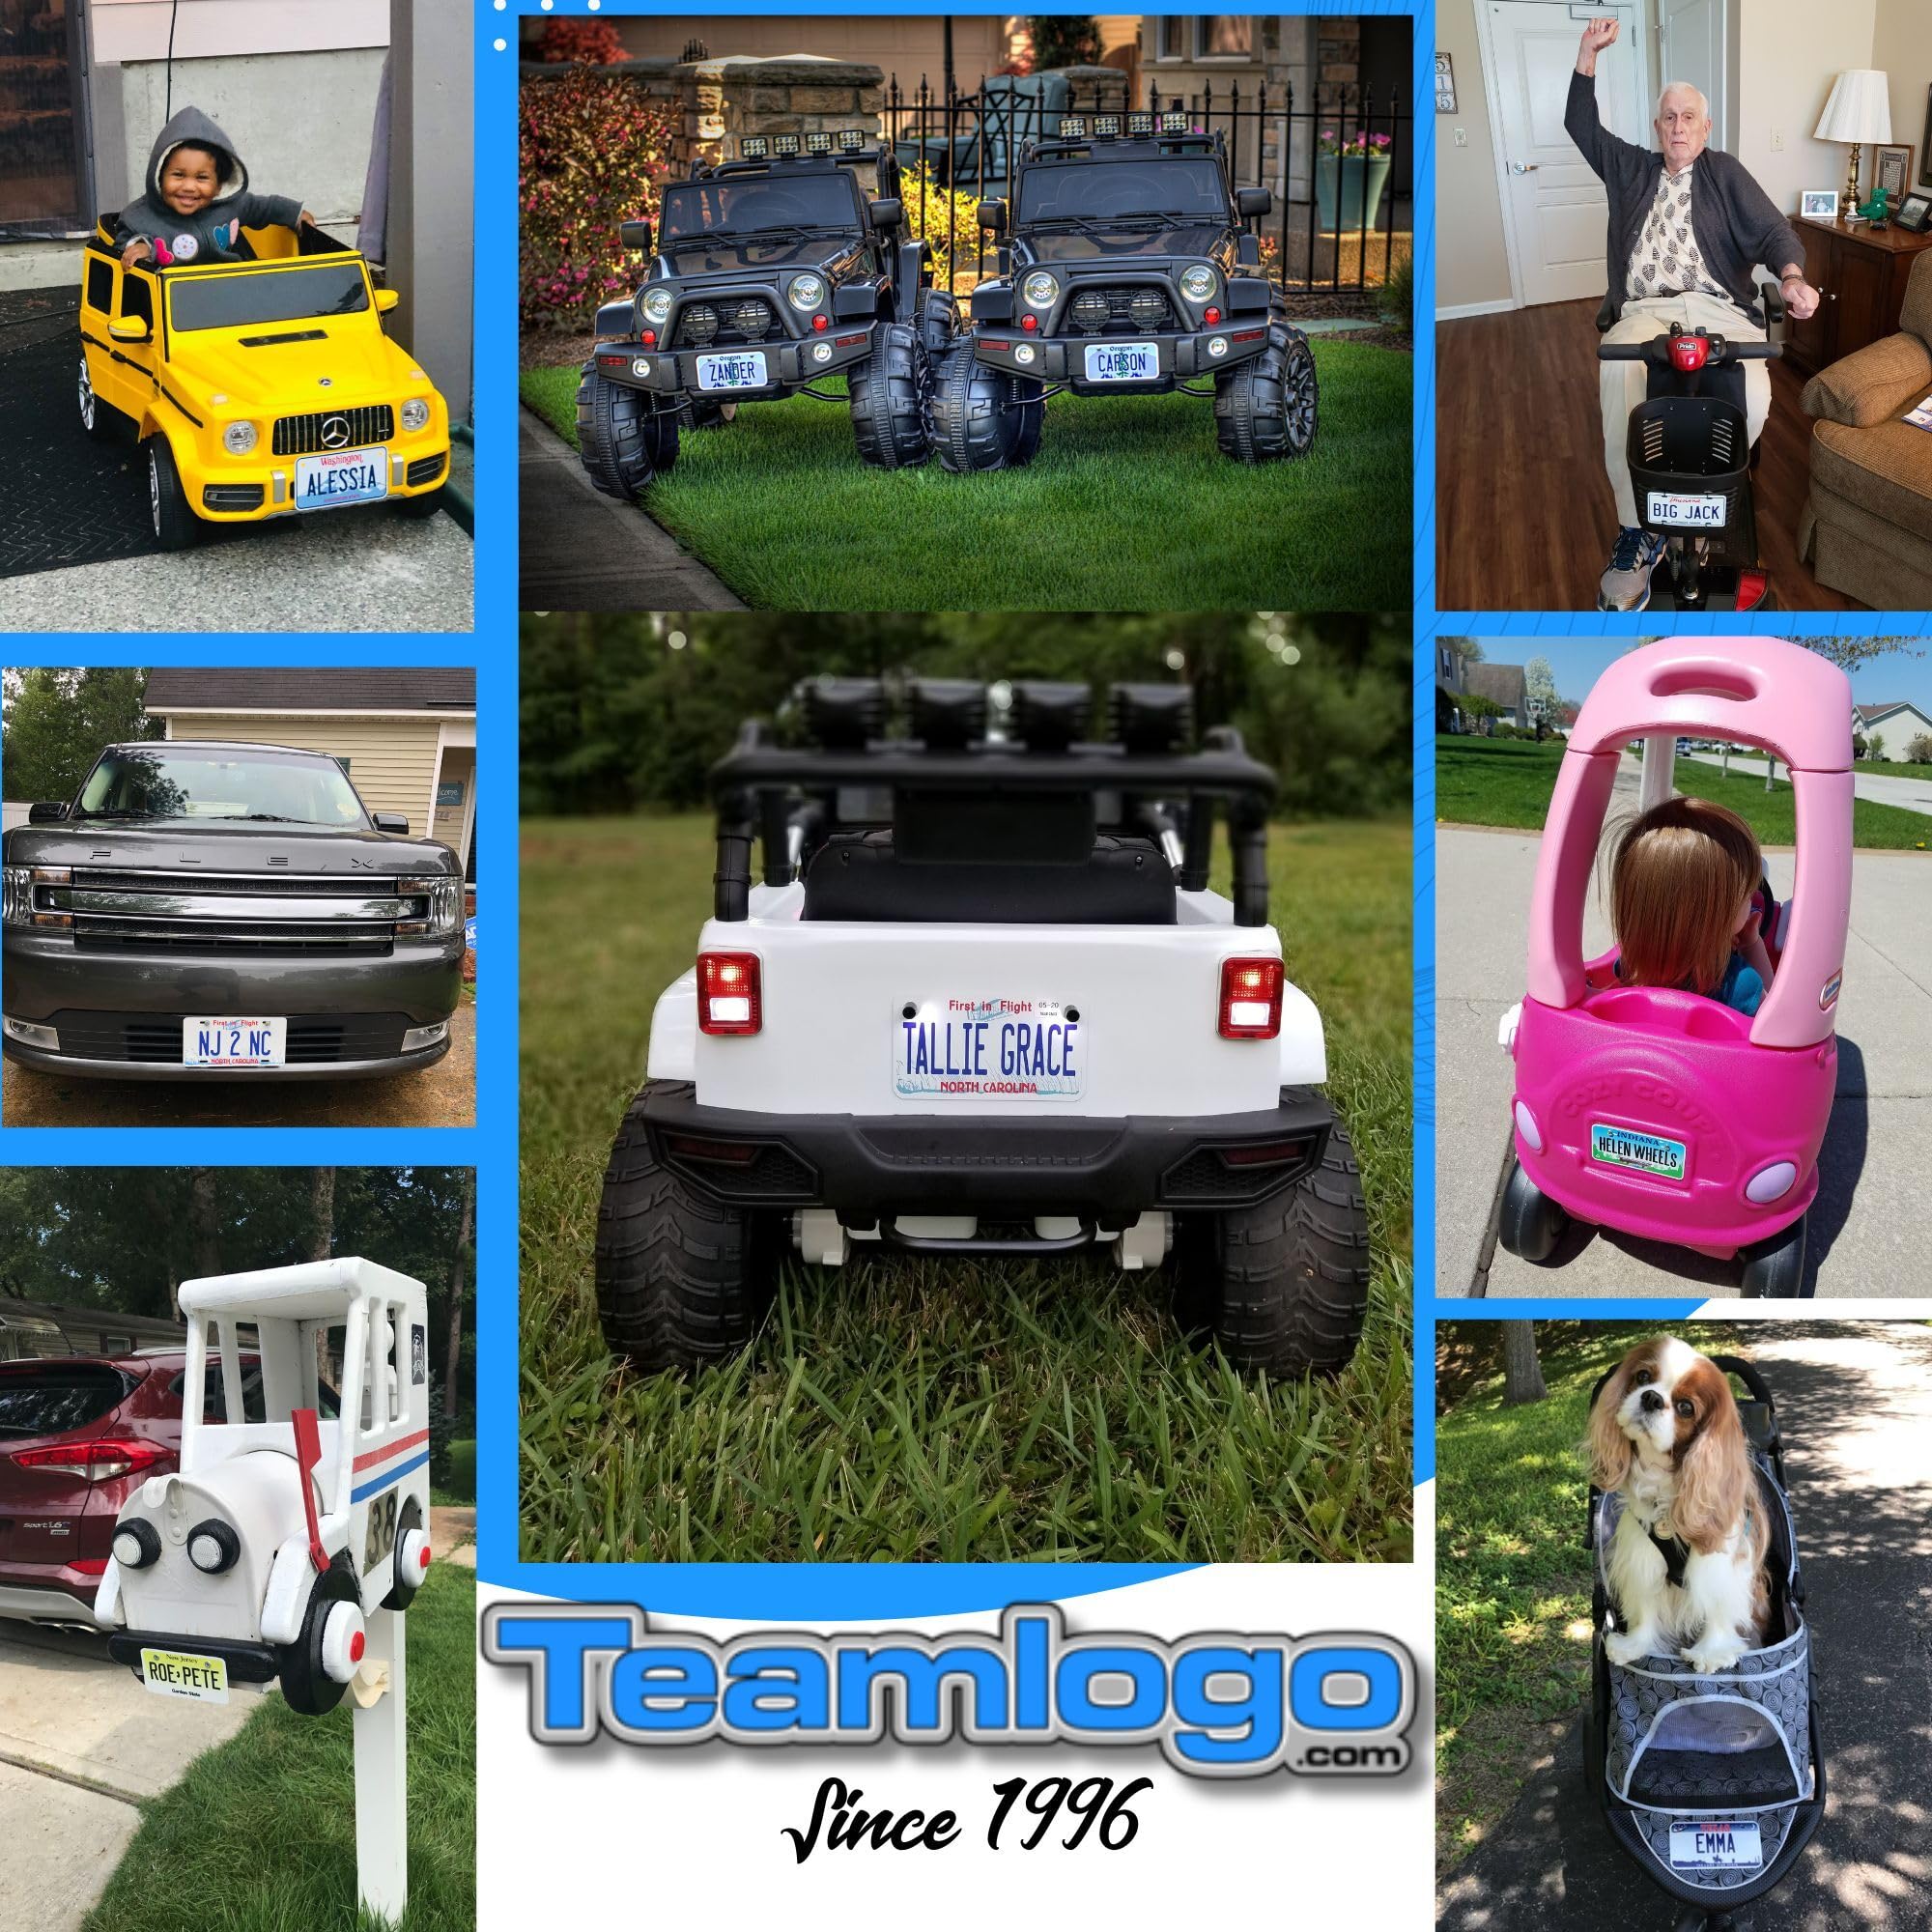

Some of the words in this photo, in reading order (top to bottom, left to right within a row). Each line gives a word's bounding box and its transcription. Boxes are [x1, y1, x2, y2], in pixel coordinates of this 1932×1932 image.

[709, 361, 755, 382] ZANDER
[1098, 353, 1146, 372] CARSON
[320, 454, 363, 467] Washington
[307, 465, 376, 497] ALESSIA
[1653, 502, 1678, 518] BIG
[1685, 505, 1719, 519] JACK
[89, 849, 374, 869] FLEX
[949, 1000, 975, 1011] First
[981, 1000, 992, 1011] in
[1000, 1000, 1033, 1014] Flight
[199, 1030, 221, 1056] NJ
[230, 1030, 241, 1056] 2
[249, 1030, 271, 1056] NC
[902, 1021, 989, 1075] TALLIE
[1001, 1023, 1078, 1077] GRACE
[940, 1081, 980, 1093] NORTH
[982, 1081, 1038, 1094] CAROLINA
[1617, 1131, 1660, 1147] INDIANA
[1599, 1136, 1632, 1157] HELEN
[1634, 1143, 1678, 1168] WHEELS
[368, 1492, 396, 1564] 38
[1700, 1823, 1731, 1832] TEXAS
[1695, 1833, 1736, 1854] EMMA
